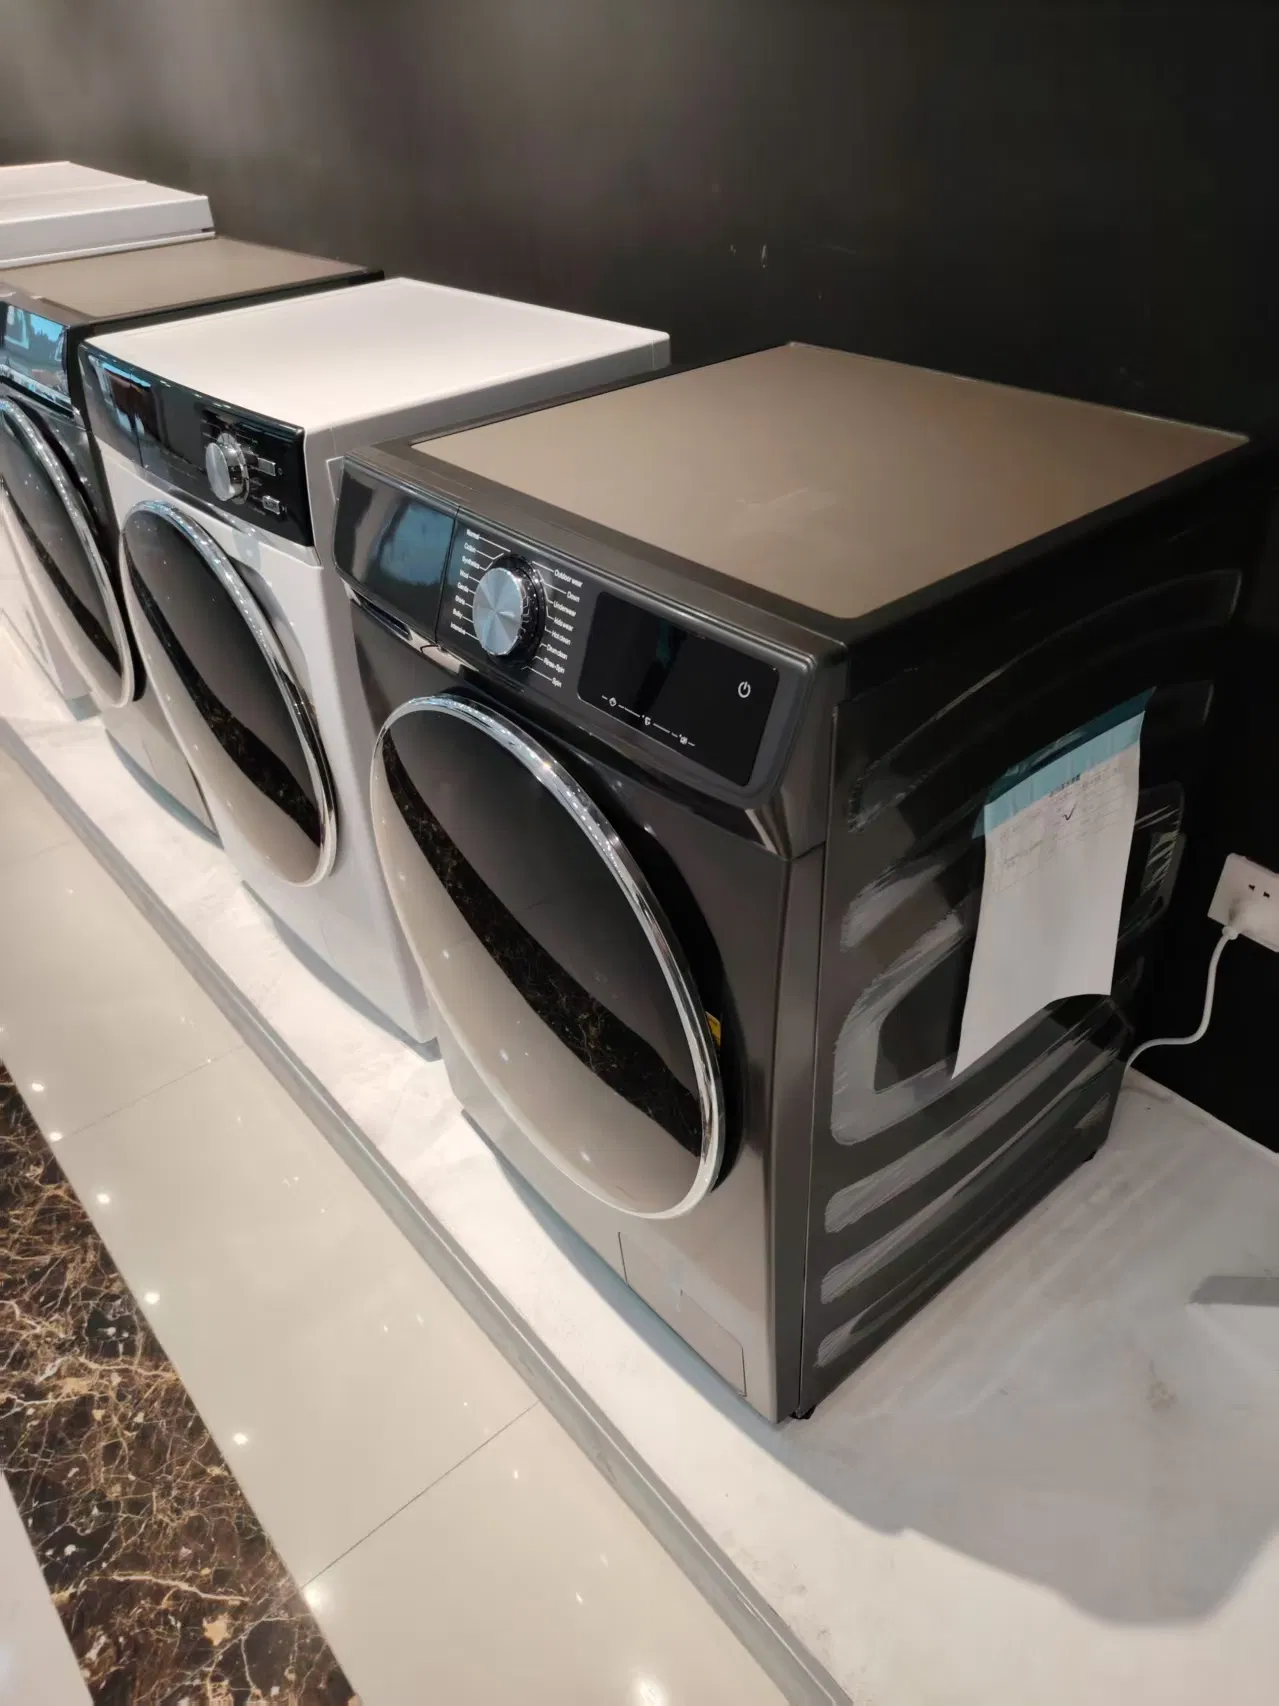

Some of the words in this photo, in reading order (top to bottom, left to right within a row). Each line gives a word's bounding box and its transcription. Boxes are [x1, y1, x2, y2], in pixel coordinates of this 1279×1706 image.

[566, 591, 580, 602] Down
[553, 600, 576, 617] Underwear
[552, 677, 562, 687] Spin
